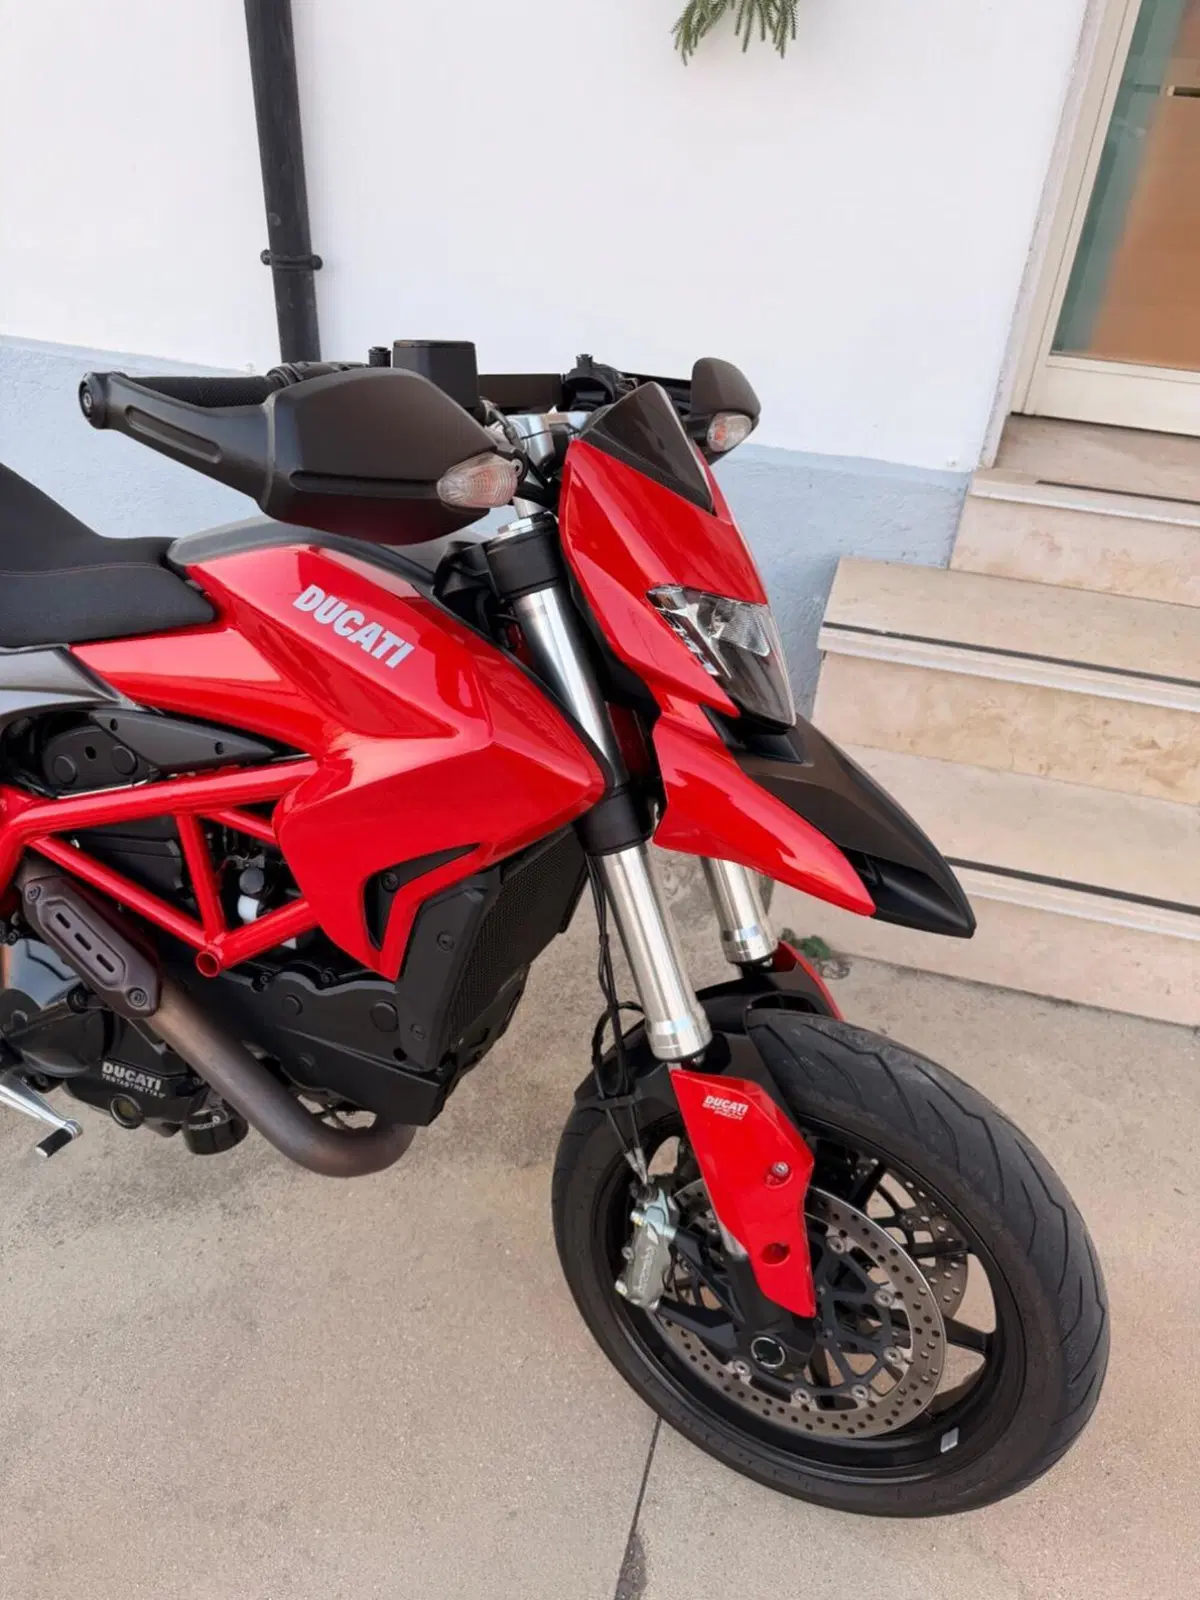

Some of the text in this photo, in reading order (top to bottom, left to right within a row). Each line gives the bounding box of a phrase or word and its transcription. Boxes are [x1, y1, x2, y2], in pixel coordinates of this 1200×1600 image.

[292, 583, 416, 670] DUCATI
[101, 1061, 162, 1090] DUCATI
[704, 1095, 749, 1113] DUCATI
